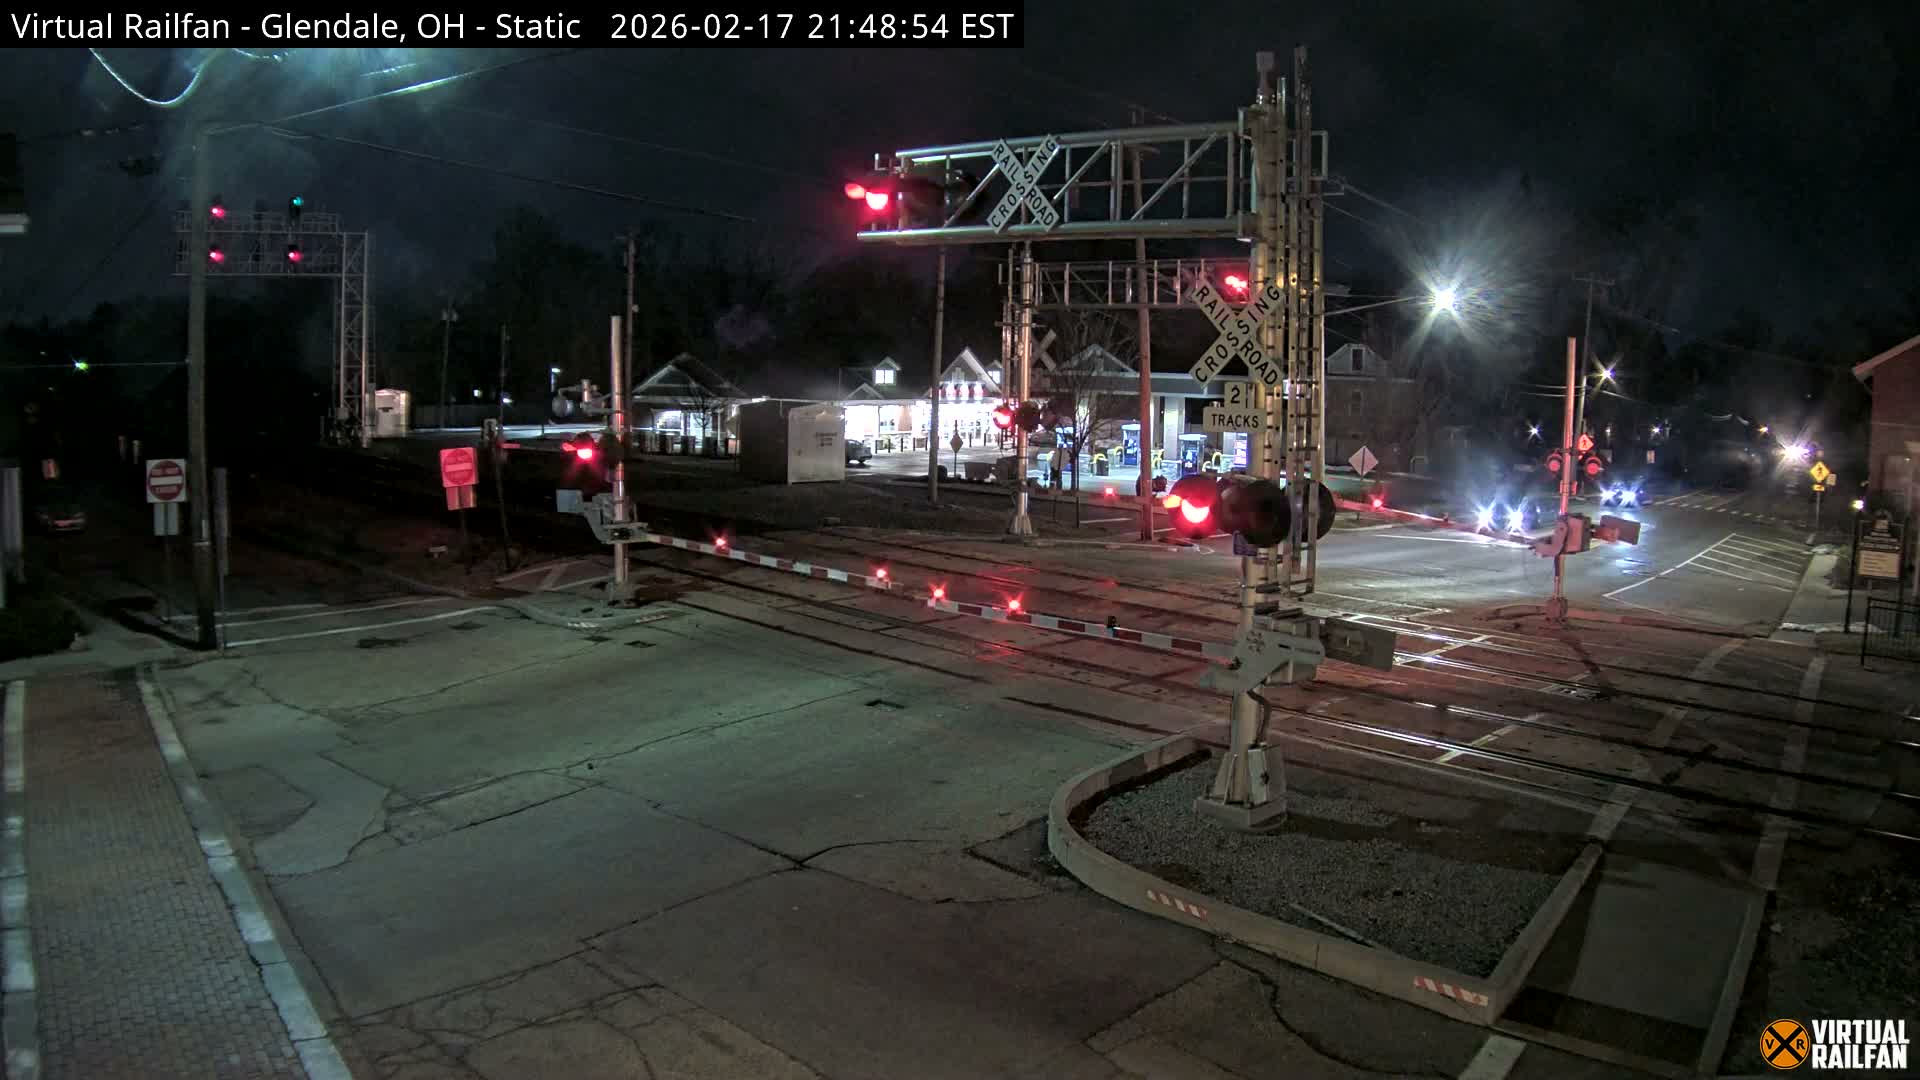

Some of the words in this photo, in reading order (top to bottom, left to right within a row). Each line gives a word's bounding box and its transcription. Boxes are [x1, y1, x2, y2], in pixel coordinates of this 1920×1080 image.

[991, 140, 1056, 228] CROSSING
[1195, 286, 1280, 383] CROSSING
[1211, 414, 1259, 428] TRACKS
[1230, 386, 1240, 404] 2
